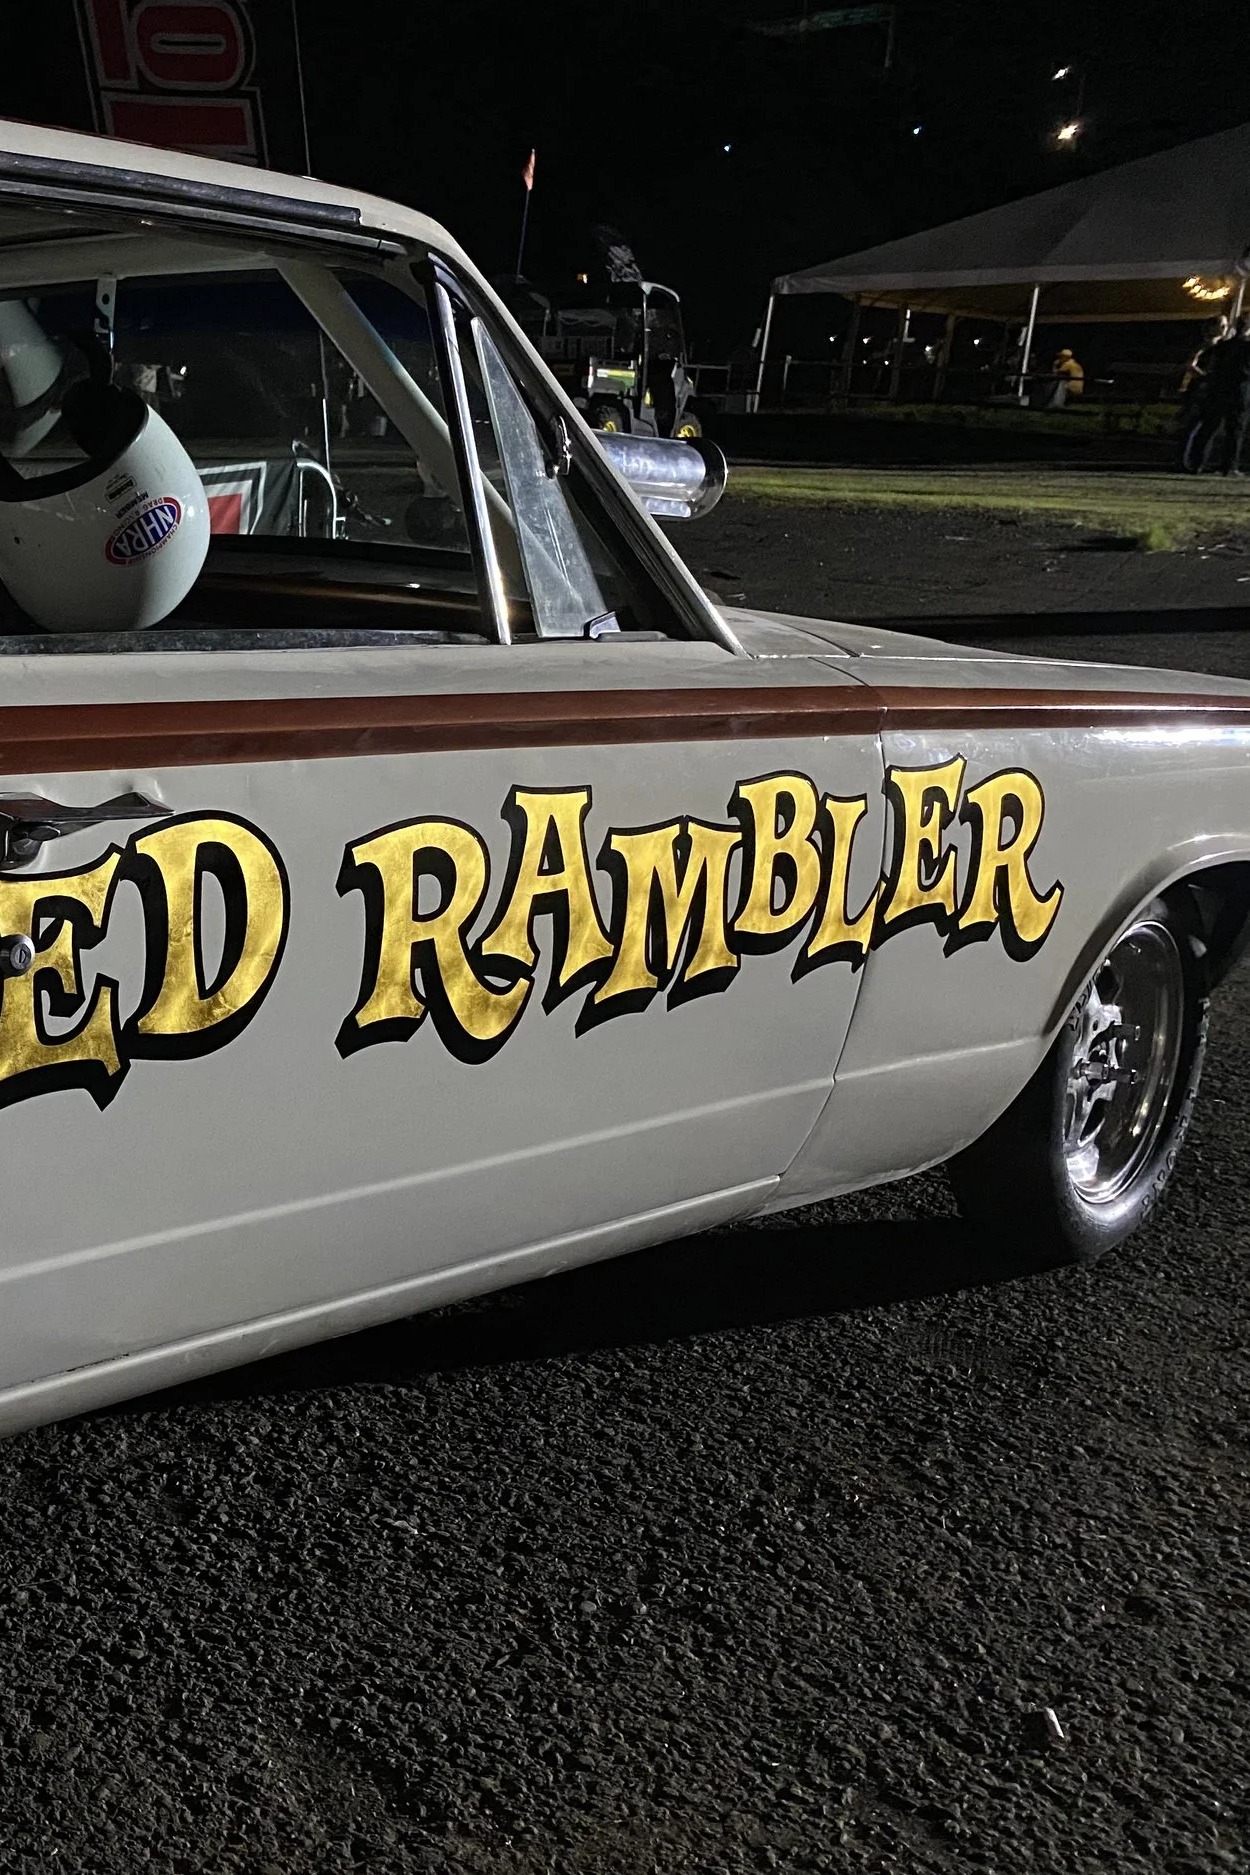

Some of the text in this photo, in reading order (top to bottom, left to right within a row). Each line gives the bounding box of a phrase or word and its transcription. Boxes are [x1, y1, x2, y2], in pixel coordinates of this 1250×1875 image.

[115, 490, 149, 518] MEMBER
[143, 497, 163, 511] DRAG
[115, 505, 174, 556] NHRA
[335, 754, 1063, 1064] RAMBLER
